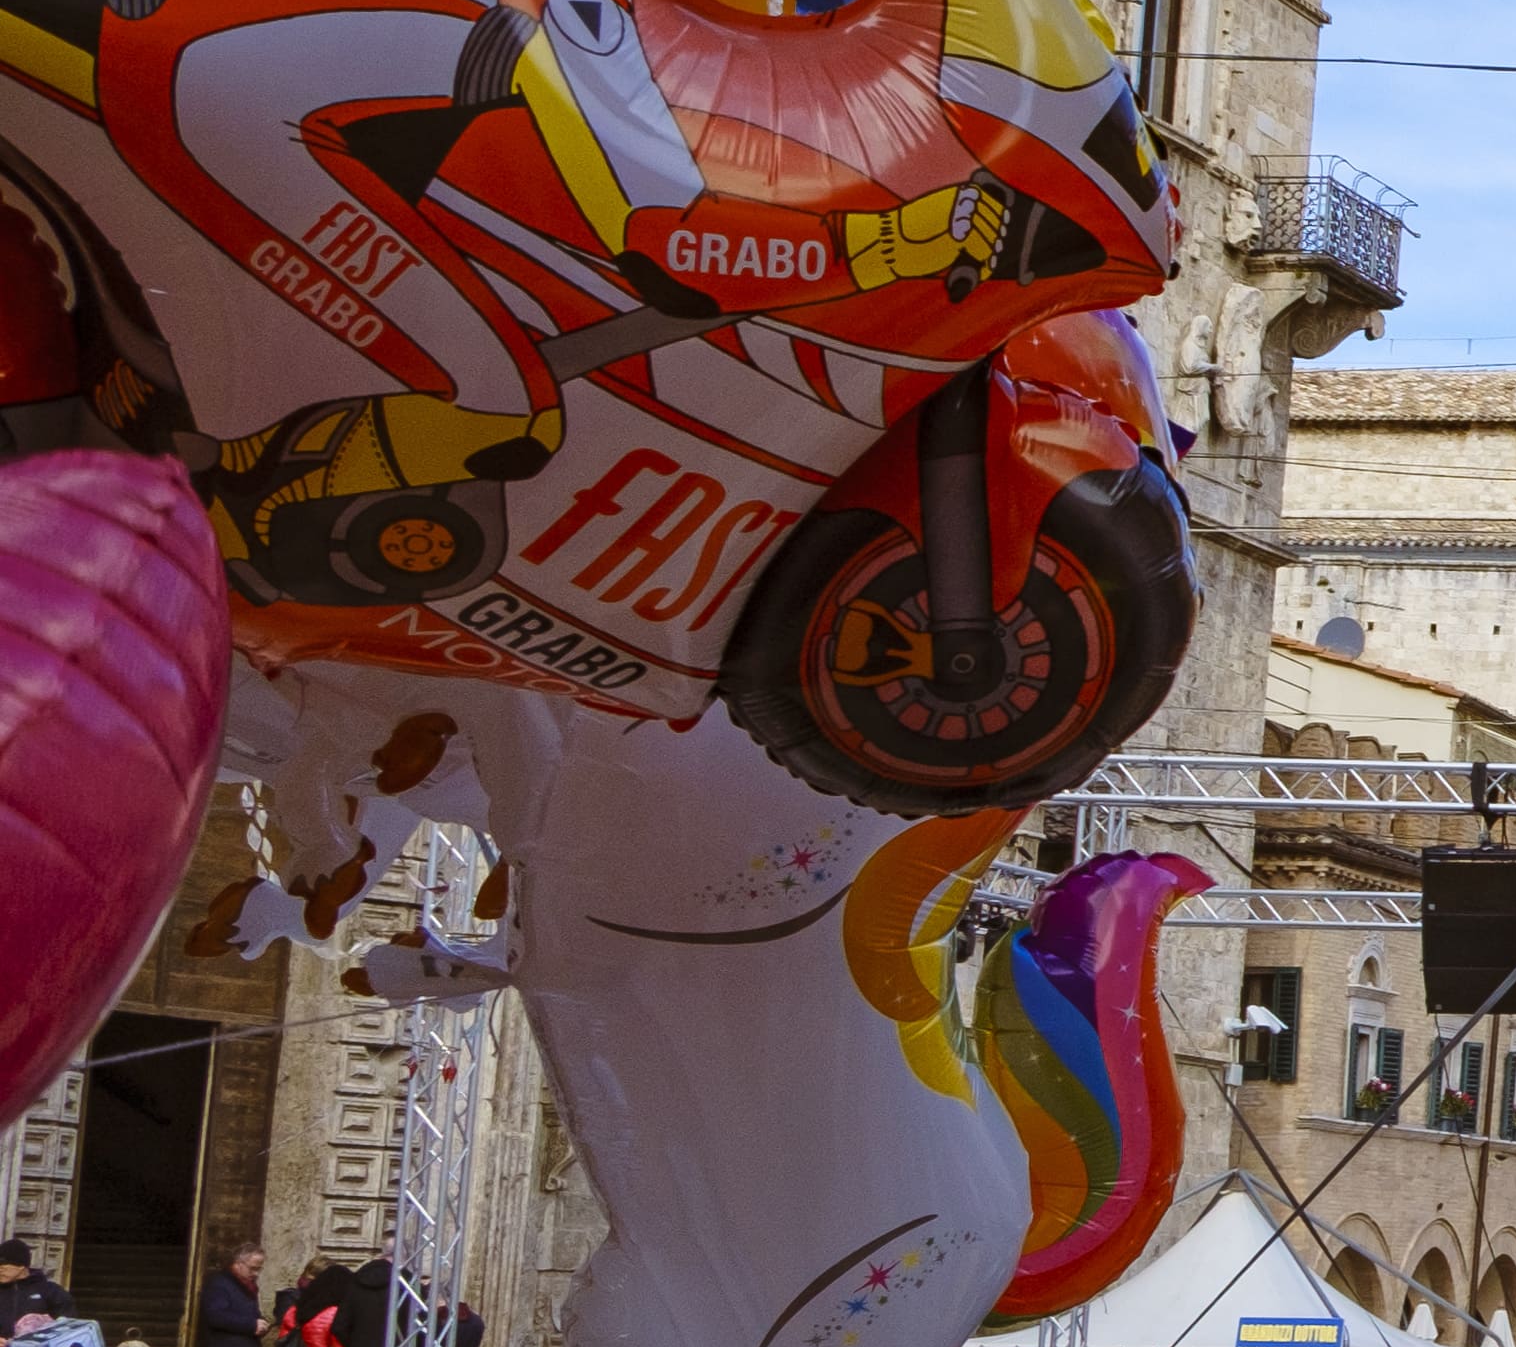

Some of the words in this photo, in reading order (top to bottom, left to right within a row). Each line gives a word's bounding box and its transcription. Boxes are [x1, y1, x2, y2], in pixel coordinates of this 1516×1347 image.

[249, 238, 385, 349] GRABO
[301, 200, 424, 300] FAST
[666, 228, 828, 283] GRABO
[518, 447, 804, 633] FAST
[456, 592, 650, 690] GRABO
